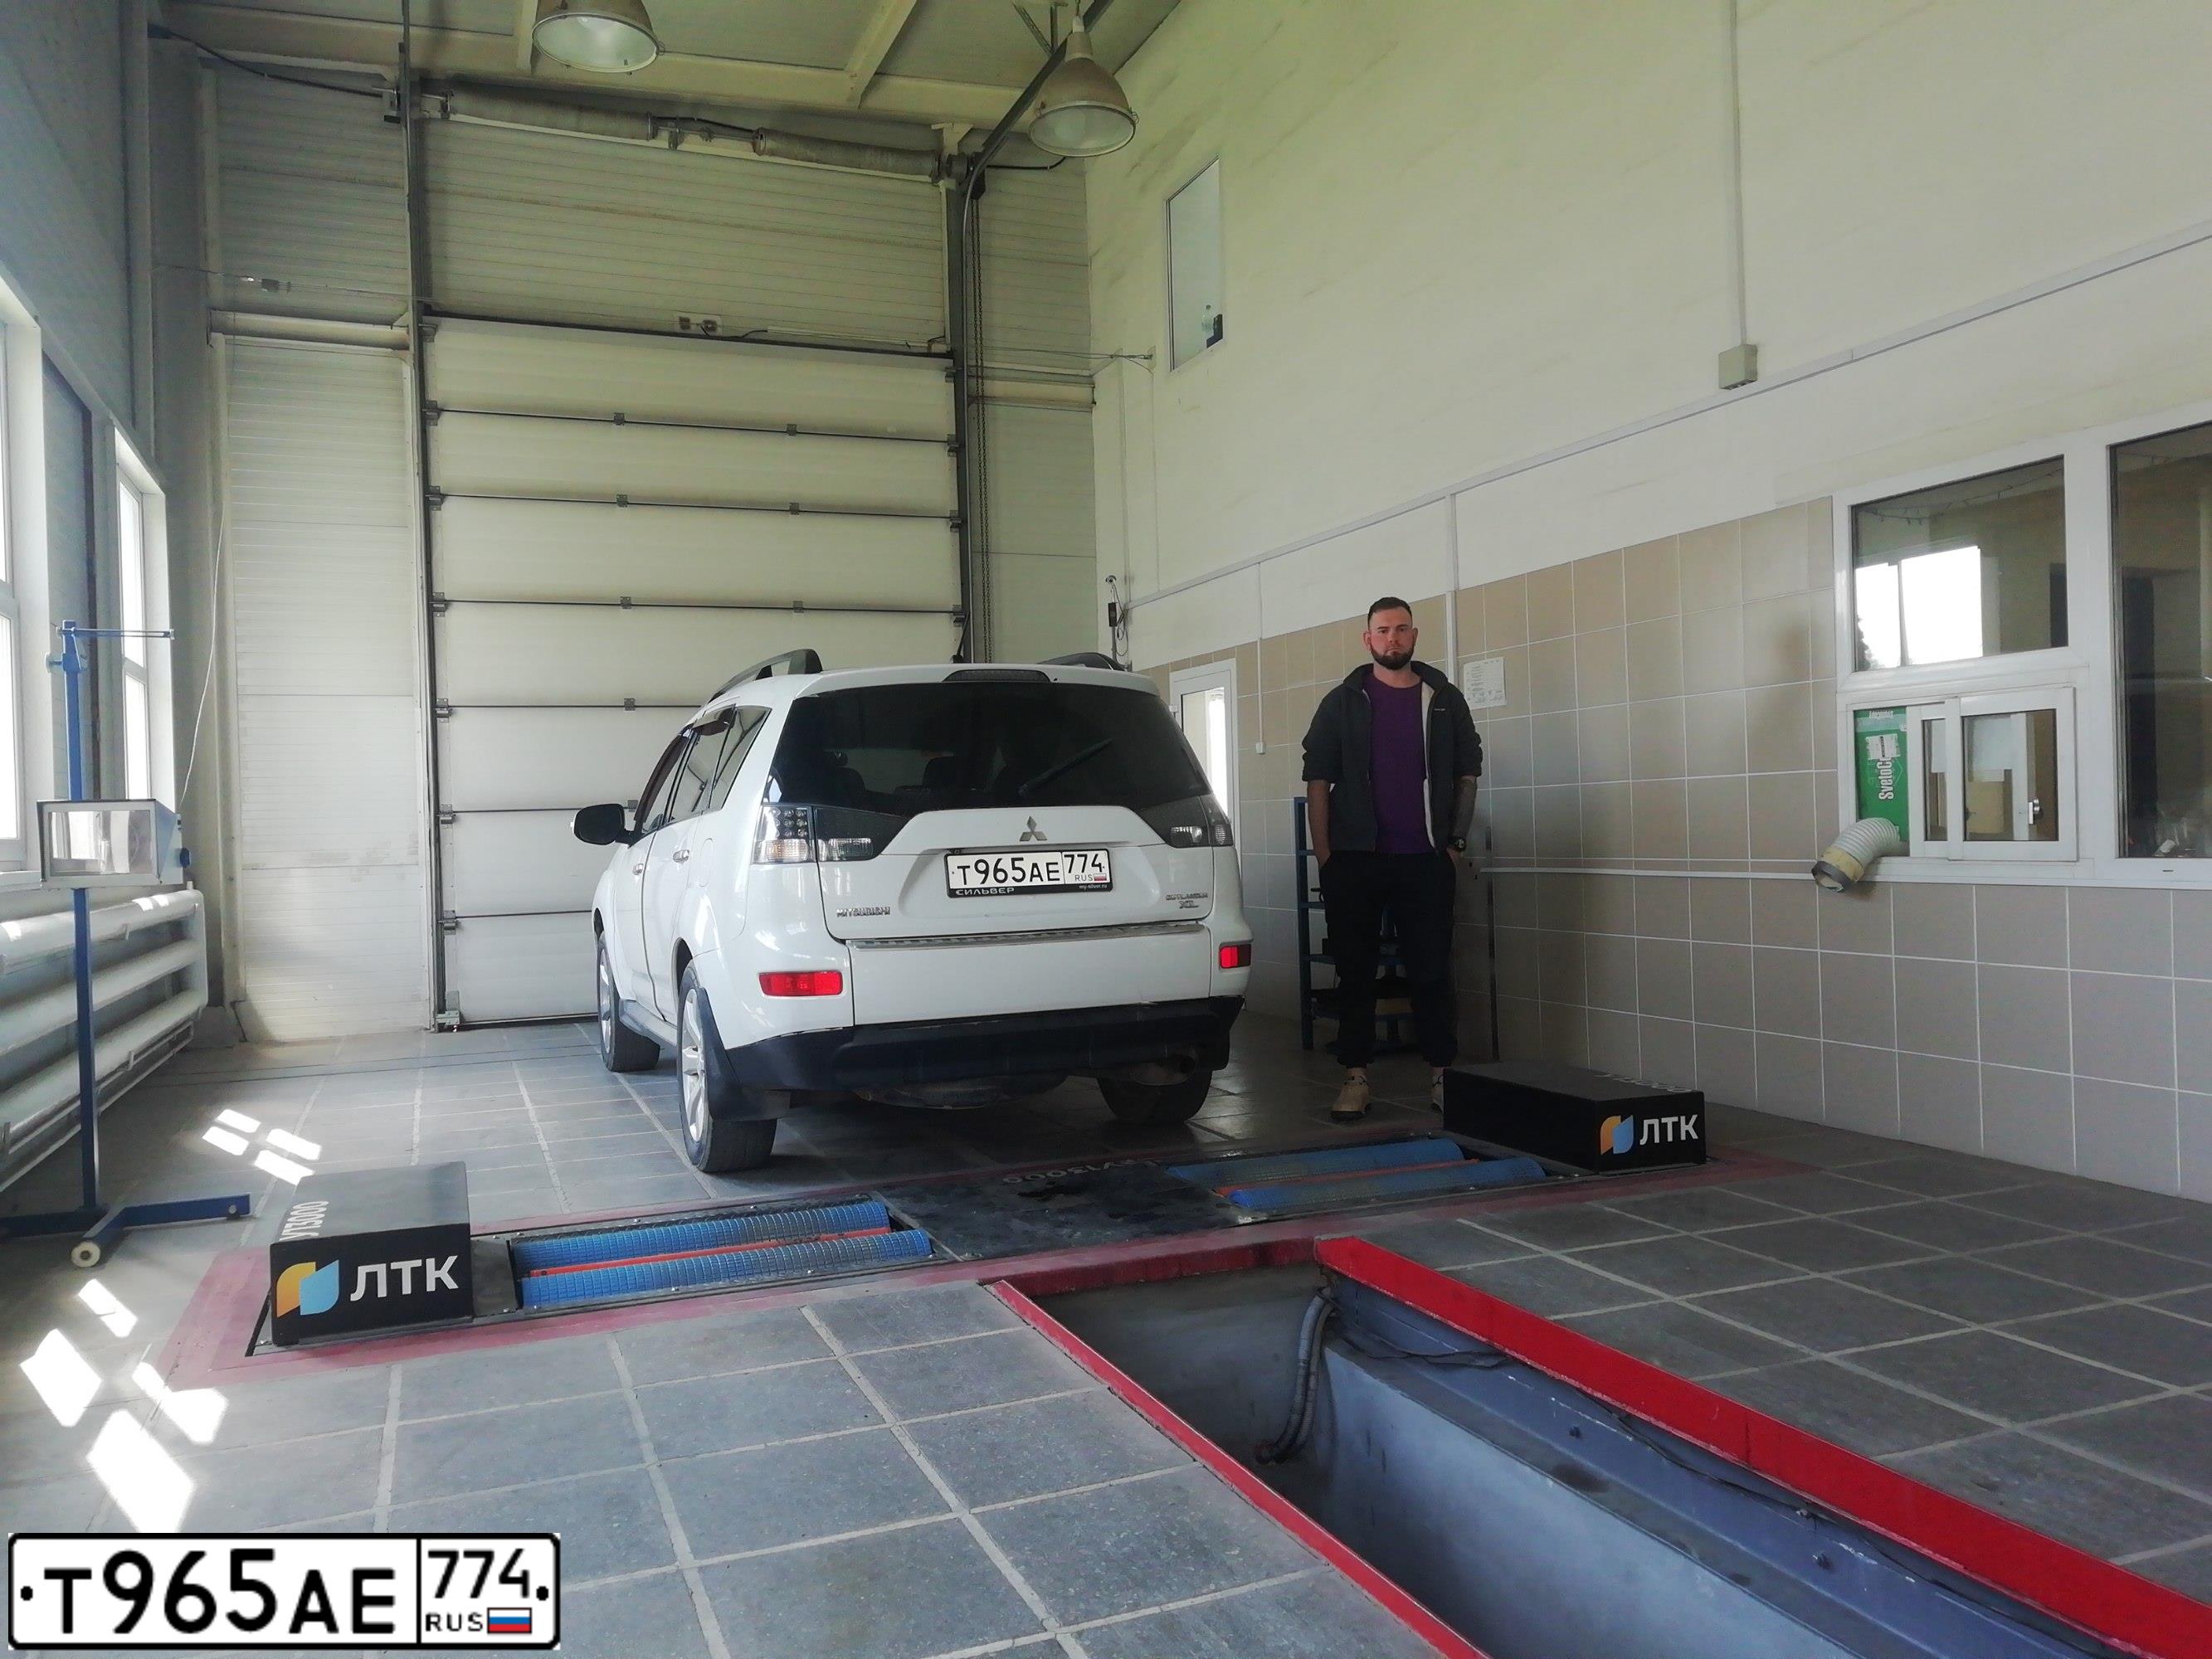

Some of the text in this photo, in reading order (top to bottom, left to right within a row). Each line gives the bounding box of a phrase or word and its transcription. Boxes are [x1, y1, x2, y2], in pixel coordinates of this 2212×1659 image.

[1064, 853, 1103, 873] 774
[1074, 873, 1094, 882] RUS
[956, 887, 1015, 897] СИЛЬВЕР
[836, 906, 891, 917] MITSUBISHI
[1639, 1113, 1699, 1146] ЛТК
[349, 1255, 459, 1302] ЛТК
